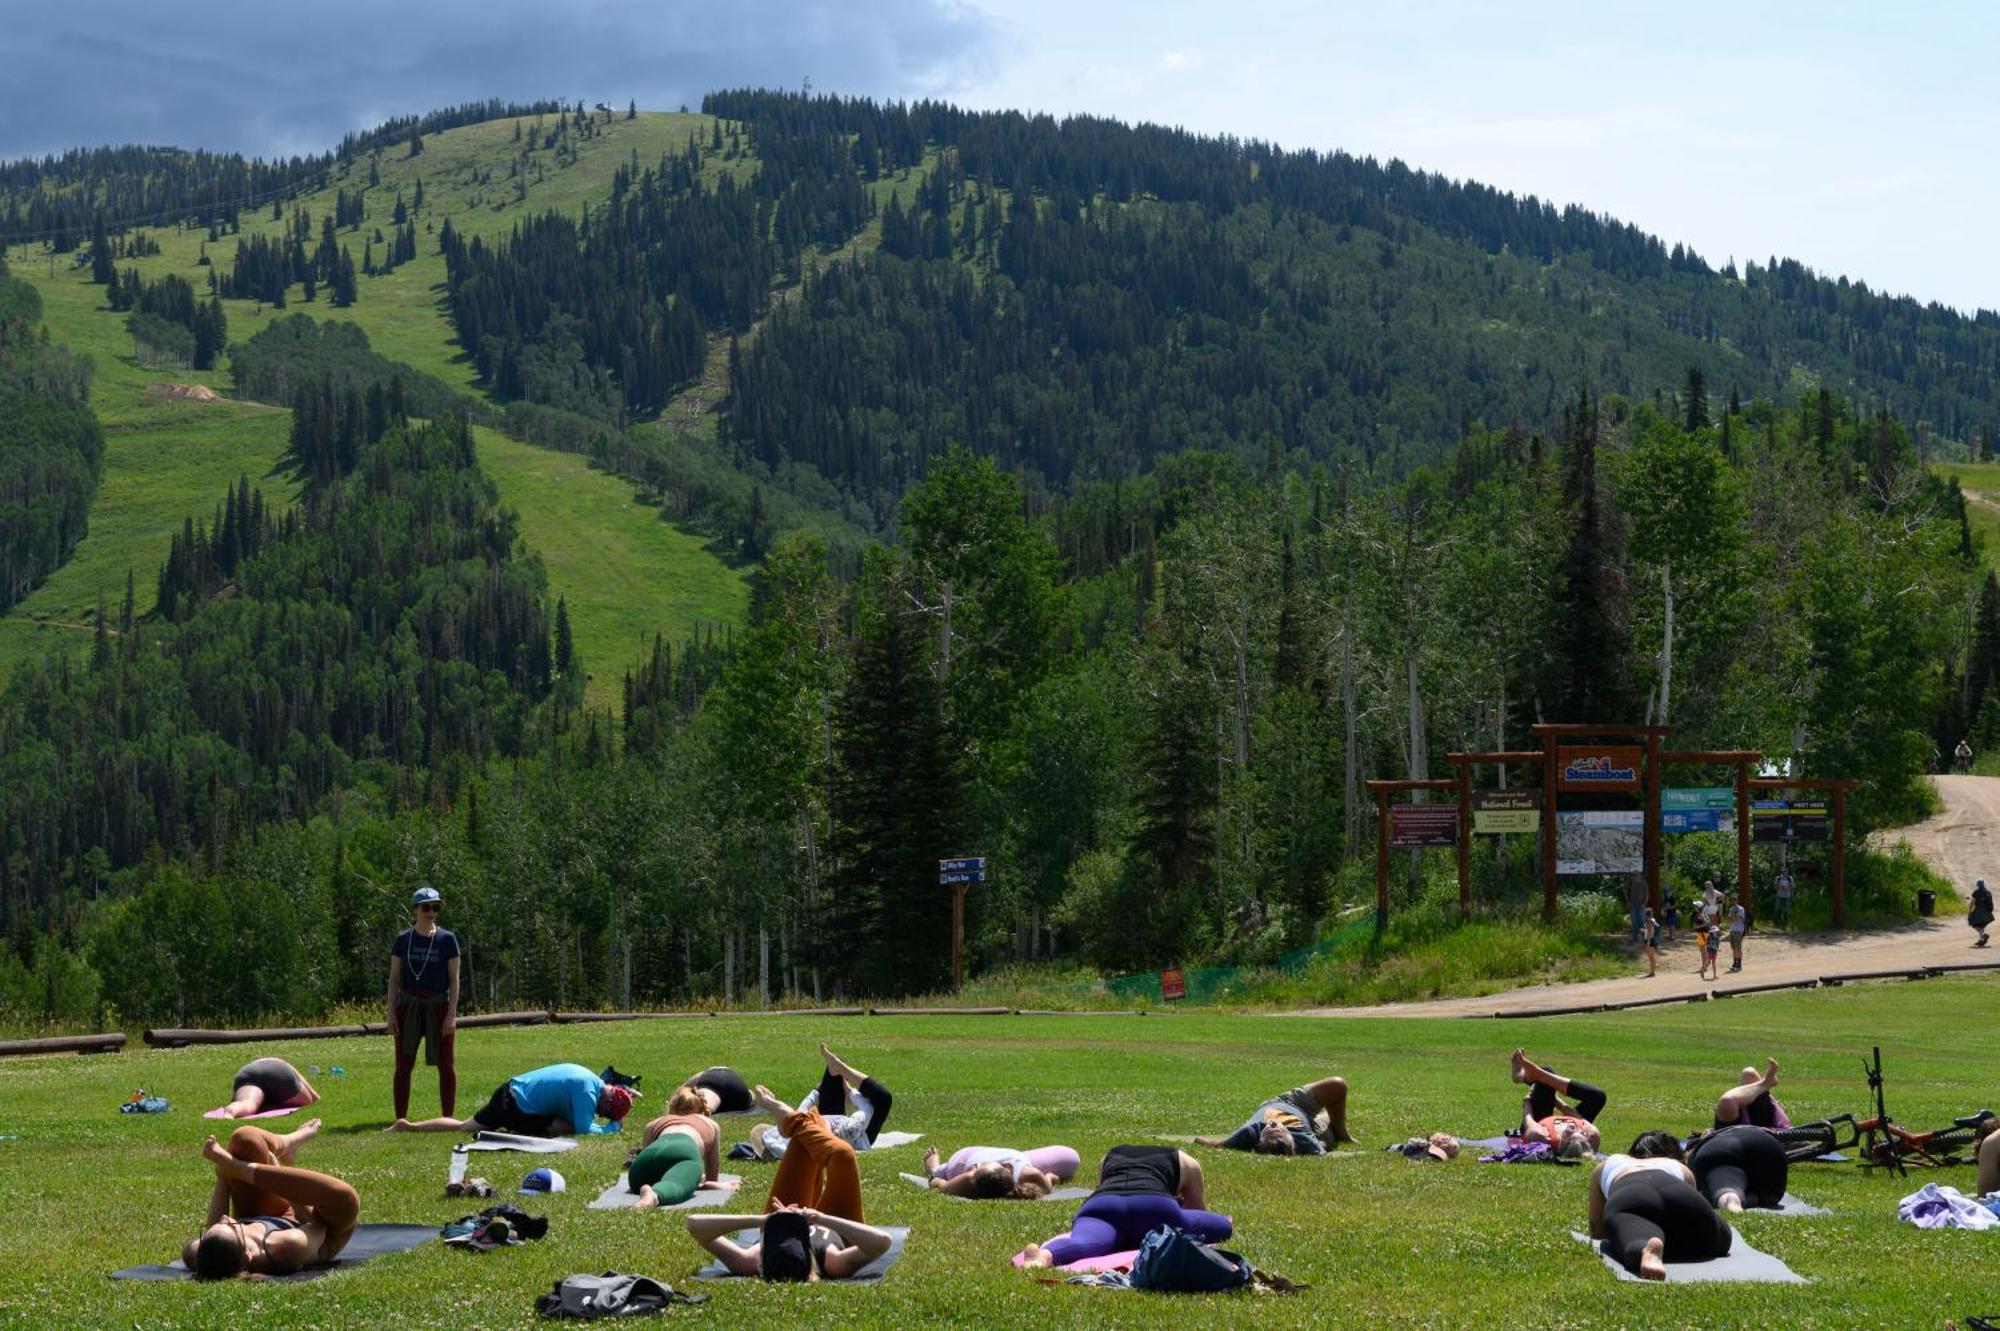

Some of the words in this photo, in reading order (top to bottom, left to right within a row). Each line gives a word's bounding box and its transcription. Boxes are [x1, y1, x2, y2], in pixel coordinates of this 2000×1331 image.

[1565, 765, 1636, 781] Steamboat
[1481, 799, 1511, 808] National
[1512, 799, 1533, 808] Forest
